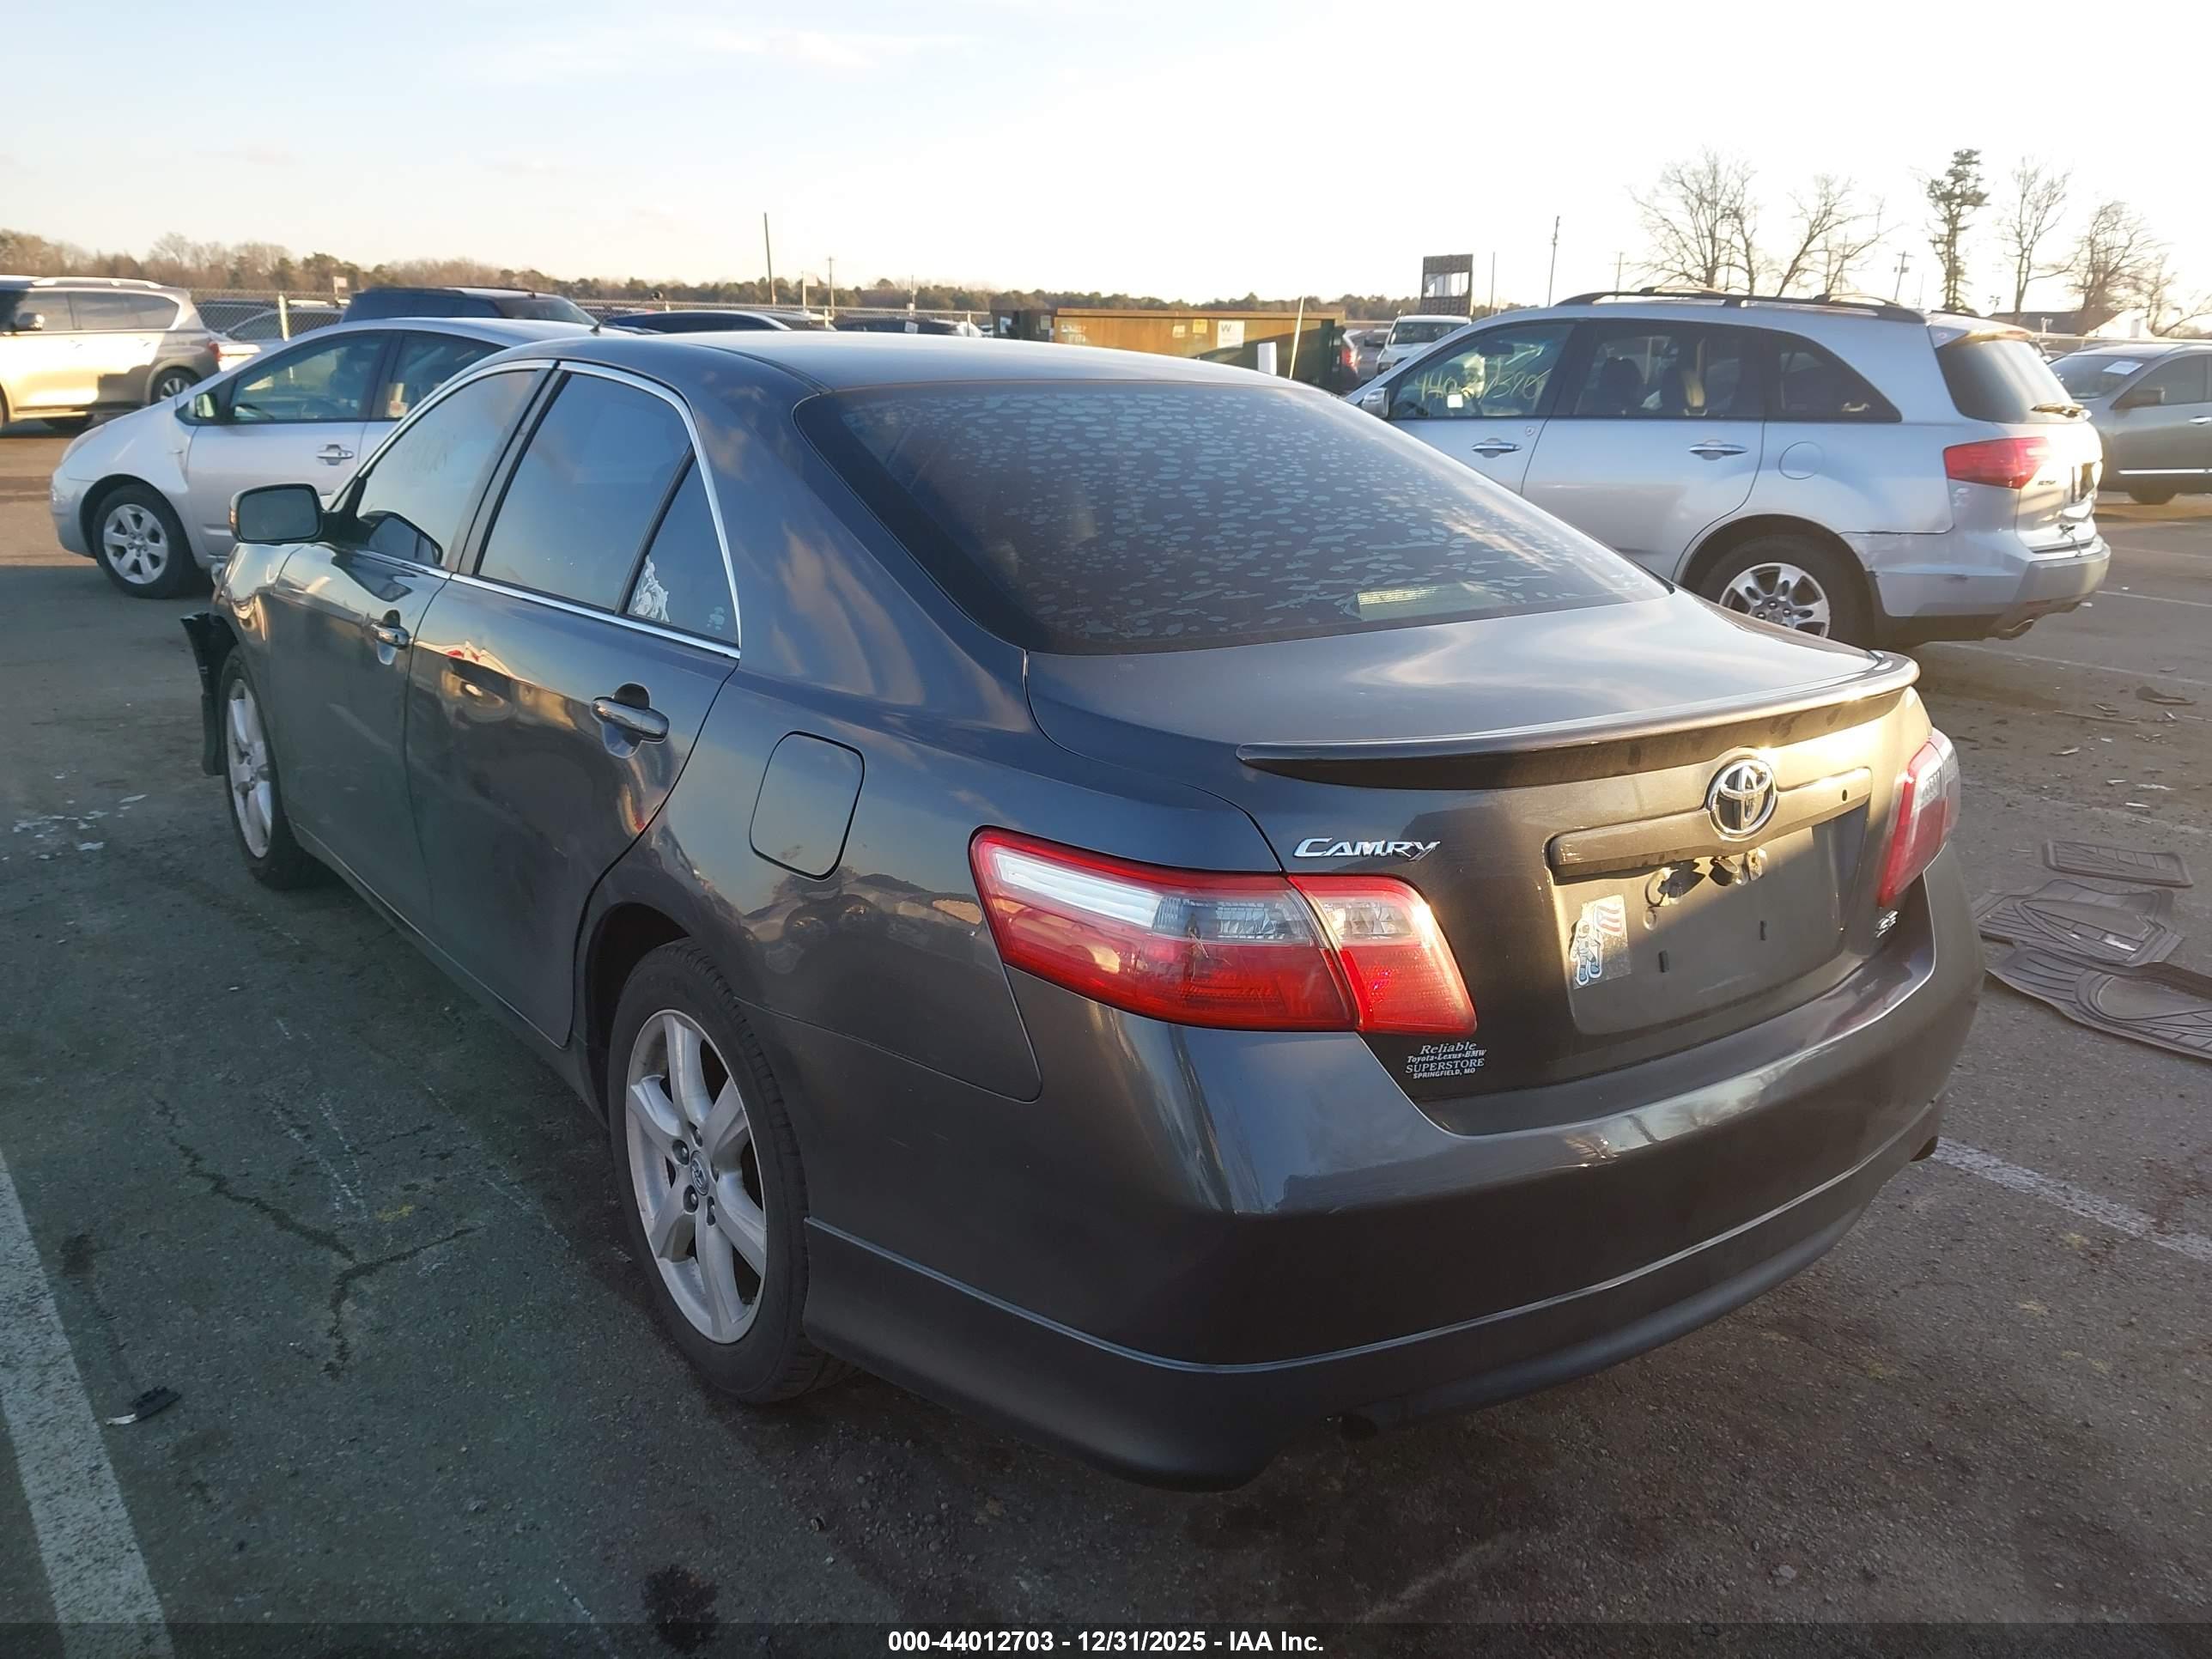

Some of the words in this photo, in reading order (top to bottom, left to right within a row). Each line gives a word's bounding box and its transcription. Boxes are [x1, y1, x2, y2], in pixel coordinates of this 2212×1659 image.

[1293, 837, 1441, 861] CAMRY
[1419, 1041, 1477, 1055] Reliable
[1406, 1058, 1485, 1073] SUPERSTORE
